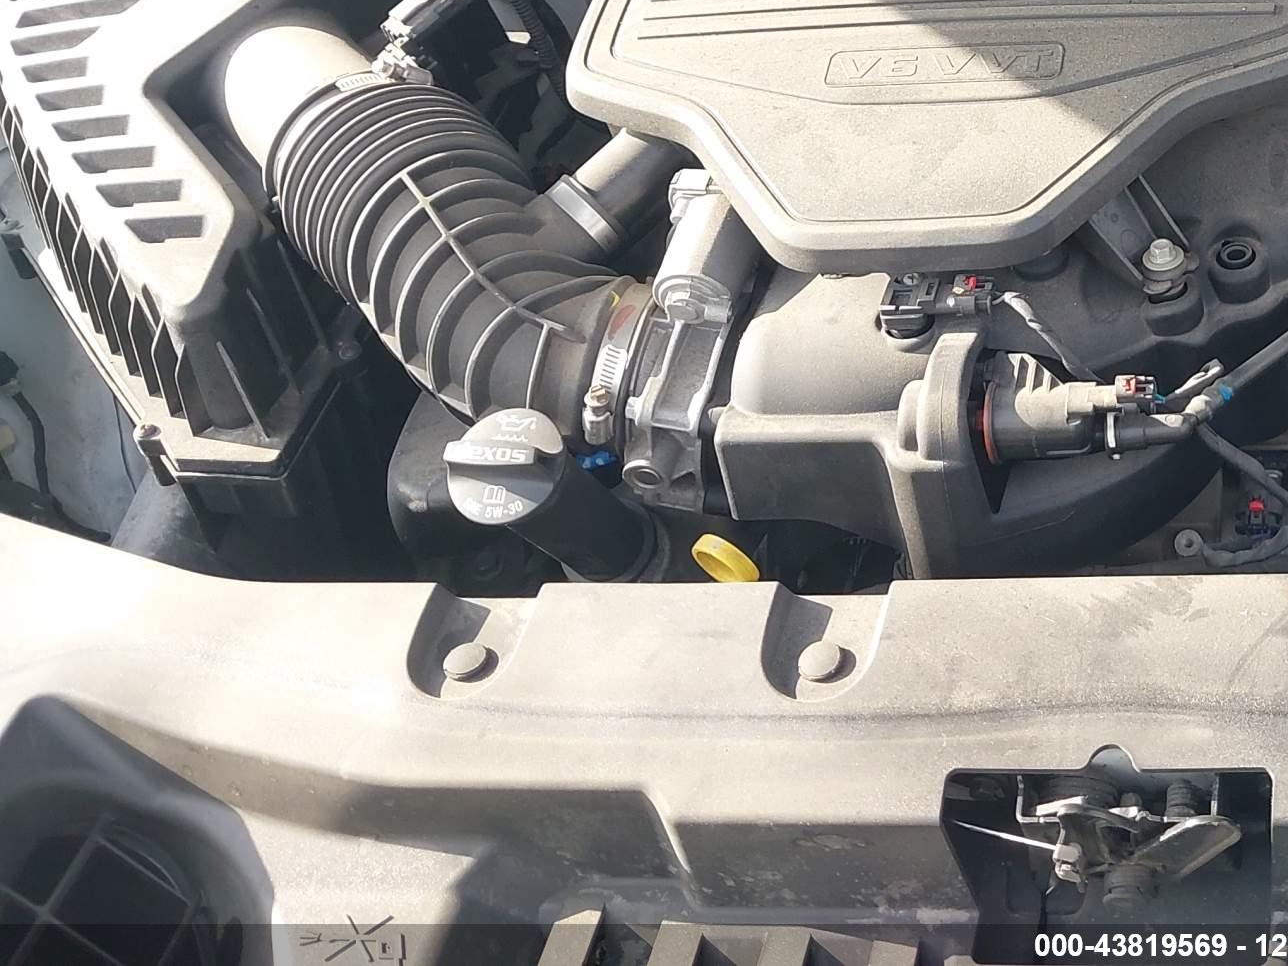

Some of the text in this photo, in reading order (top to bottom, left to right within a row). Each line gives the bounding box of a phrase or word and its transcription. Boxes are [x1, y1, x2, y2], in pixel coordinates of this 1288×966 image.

[839, 49, 1054, 80] V6 VVT
[484, 499, 523, 518] 5W-30
